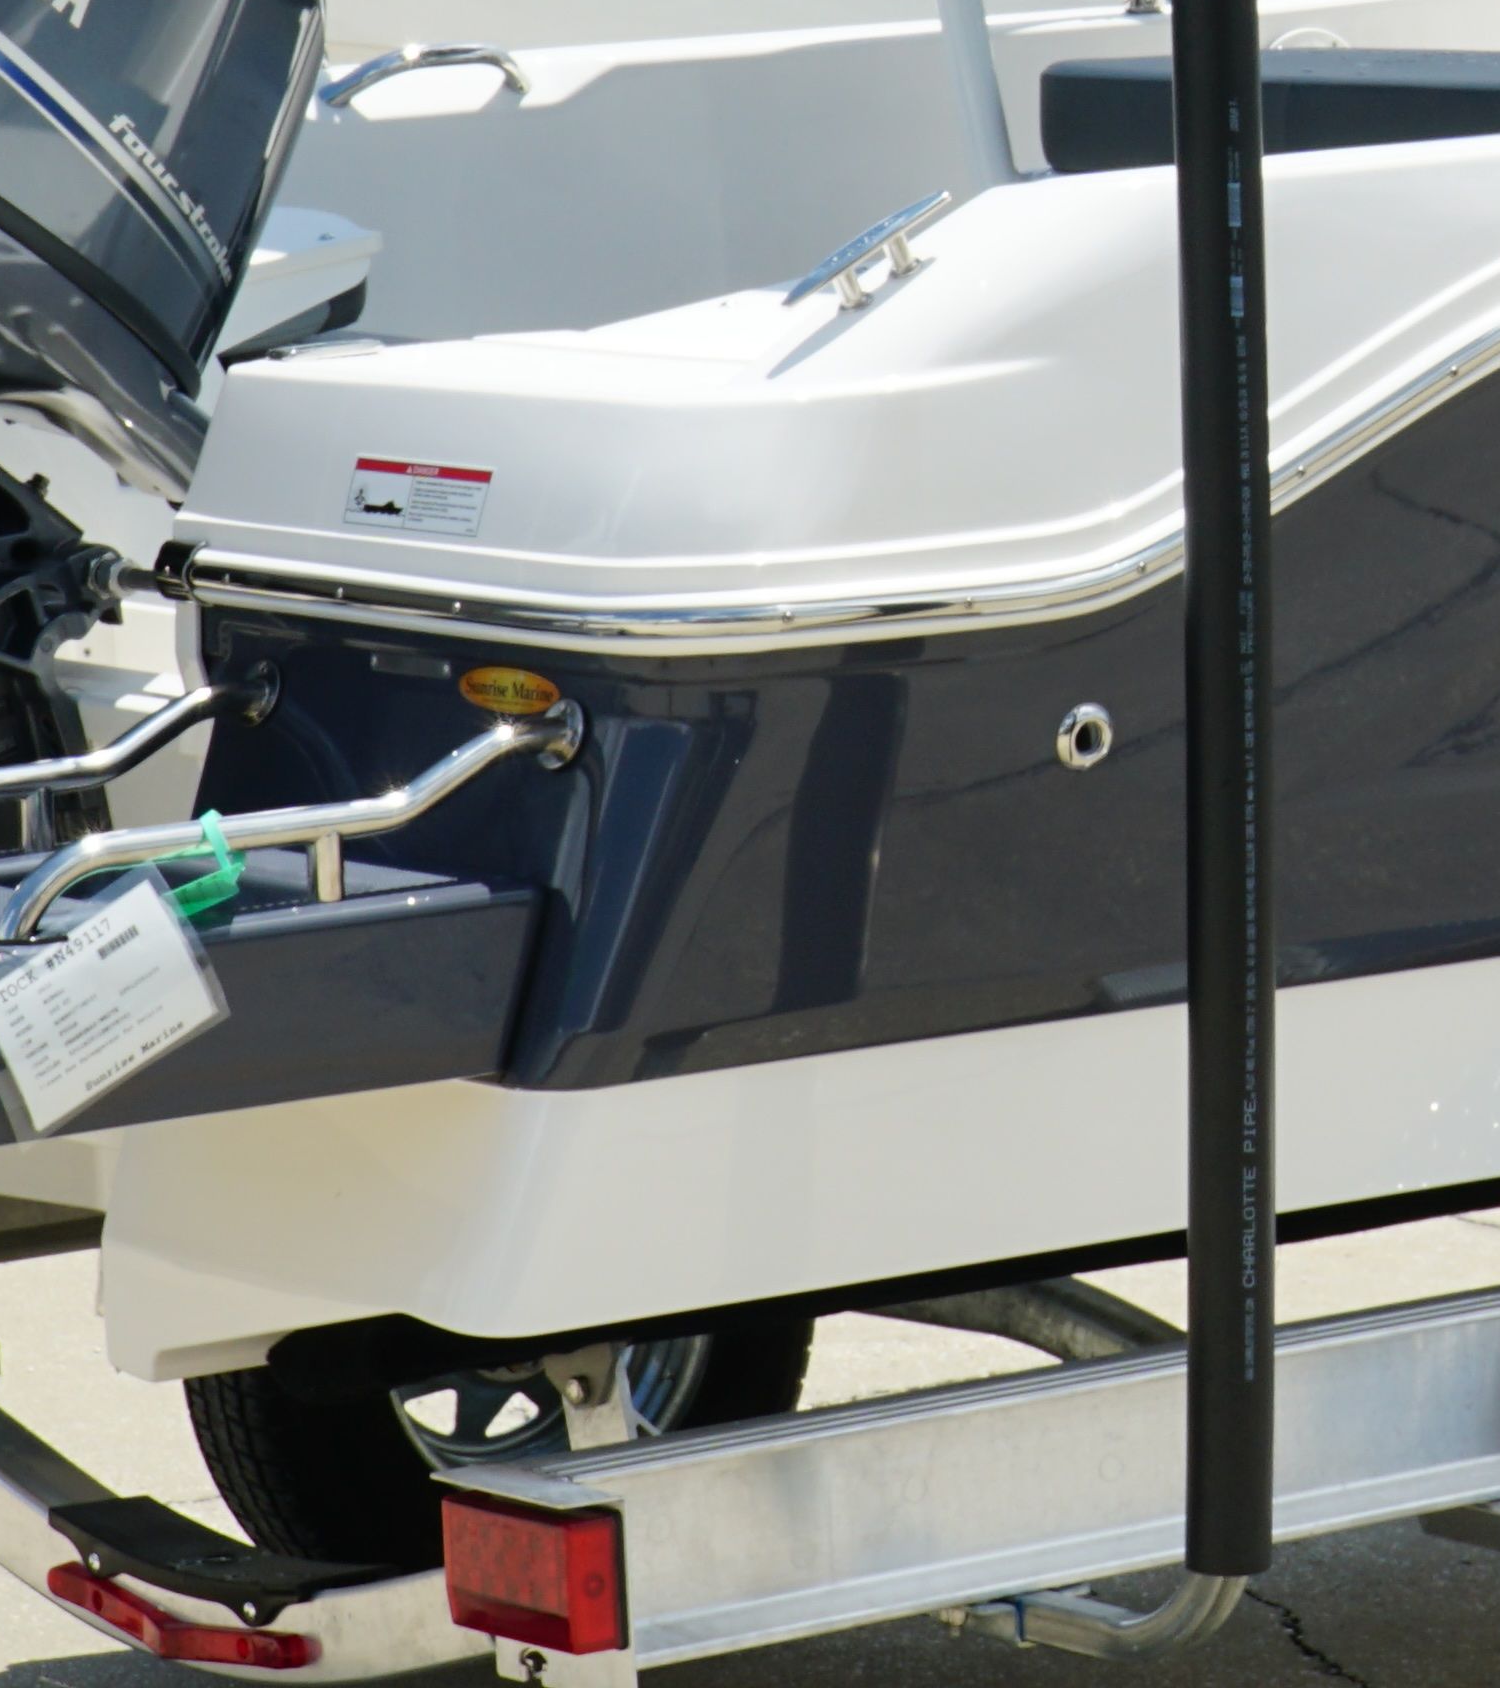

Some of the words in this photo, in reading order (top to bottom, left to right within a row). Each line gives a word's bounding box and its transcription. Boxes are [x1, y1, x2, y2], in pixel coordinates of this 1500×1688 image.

[45, 917, 113, 970] #N49117
[140, 1020, 186, 1055] Marine
[1241, 1166, 1257, 1289] CHARLOTTE
